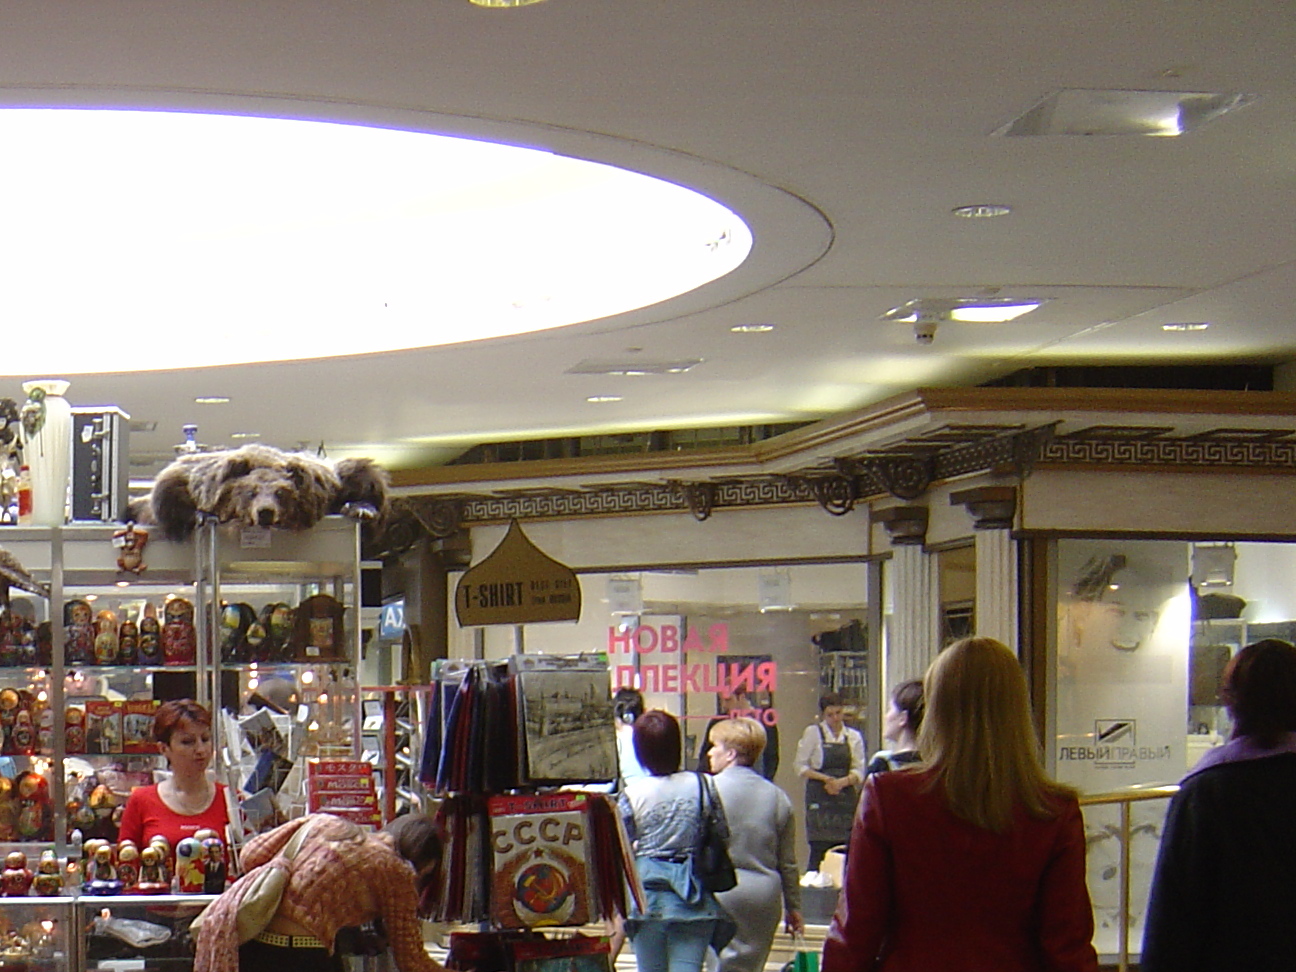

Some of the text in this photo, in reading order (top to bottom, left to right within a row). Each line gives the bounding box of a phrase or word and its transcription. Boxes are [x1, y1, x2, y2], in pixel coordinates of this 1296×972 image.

[461, 581, 523, 609] T-SHIRT
[608, 623, 729, 654] НОВАЯ
[612, 661, 778, 700] ЛЛЕКЦИЯ
